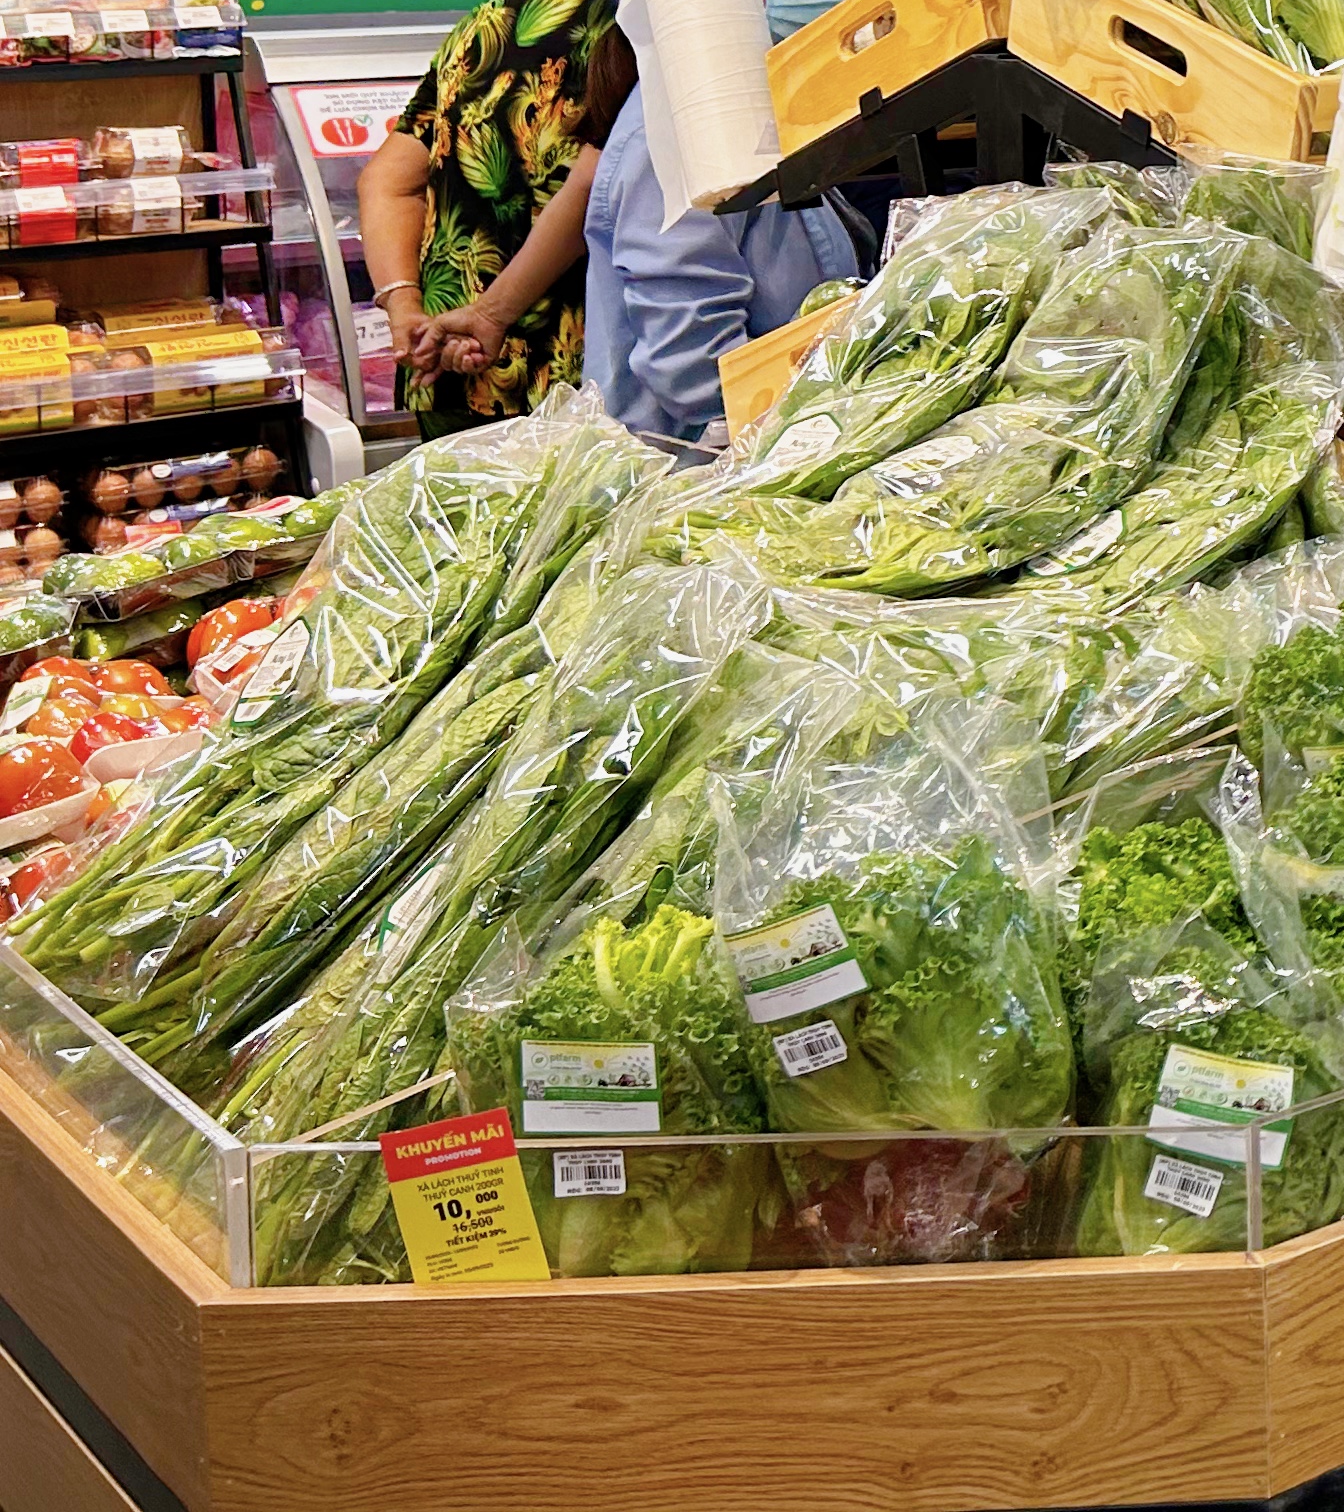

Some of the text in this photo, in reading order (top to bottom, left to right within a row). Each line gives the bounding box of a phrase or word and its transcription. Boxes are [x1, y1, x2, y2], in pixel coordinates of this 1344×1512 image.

[395, 1123, 505, 1160] KHUYẾN MÃI
[425, 1147, 482, 1166] PROMOTION
[417, 1181, 430, 1192] XÀ
[430, 1176, 455, 1190] LÁCH
[482, 1166, 505, 1179] TINH
[449, 1185, 475, 1197] CANH
[476, 1177, 505, 1191] 200GR
[432, 1190, 499, 1222] 10, 000
[445, 1235, 464, 1248] TIẾT
[465, 1230, 488, 1244] KIỆM
